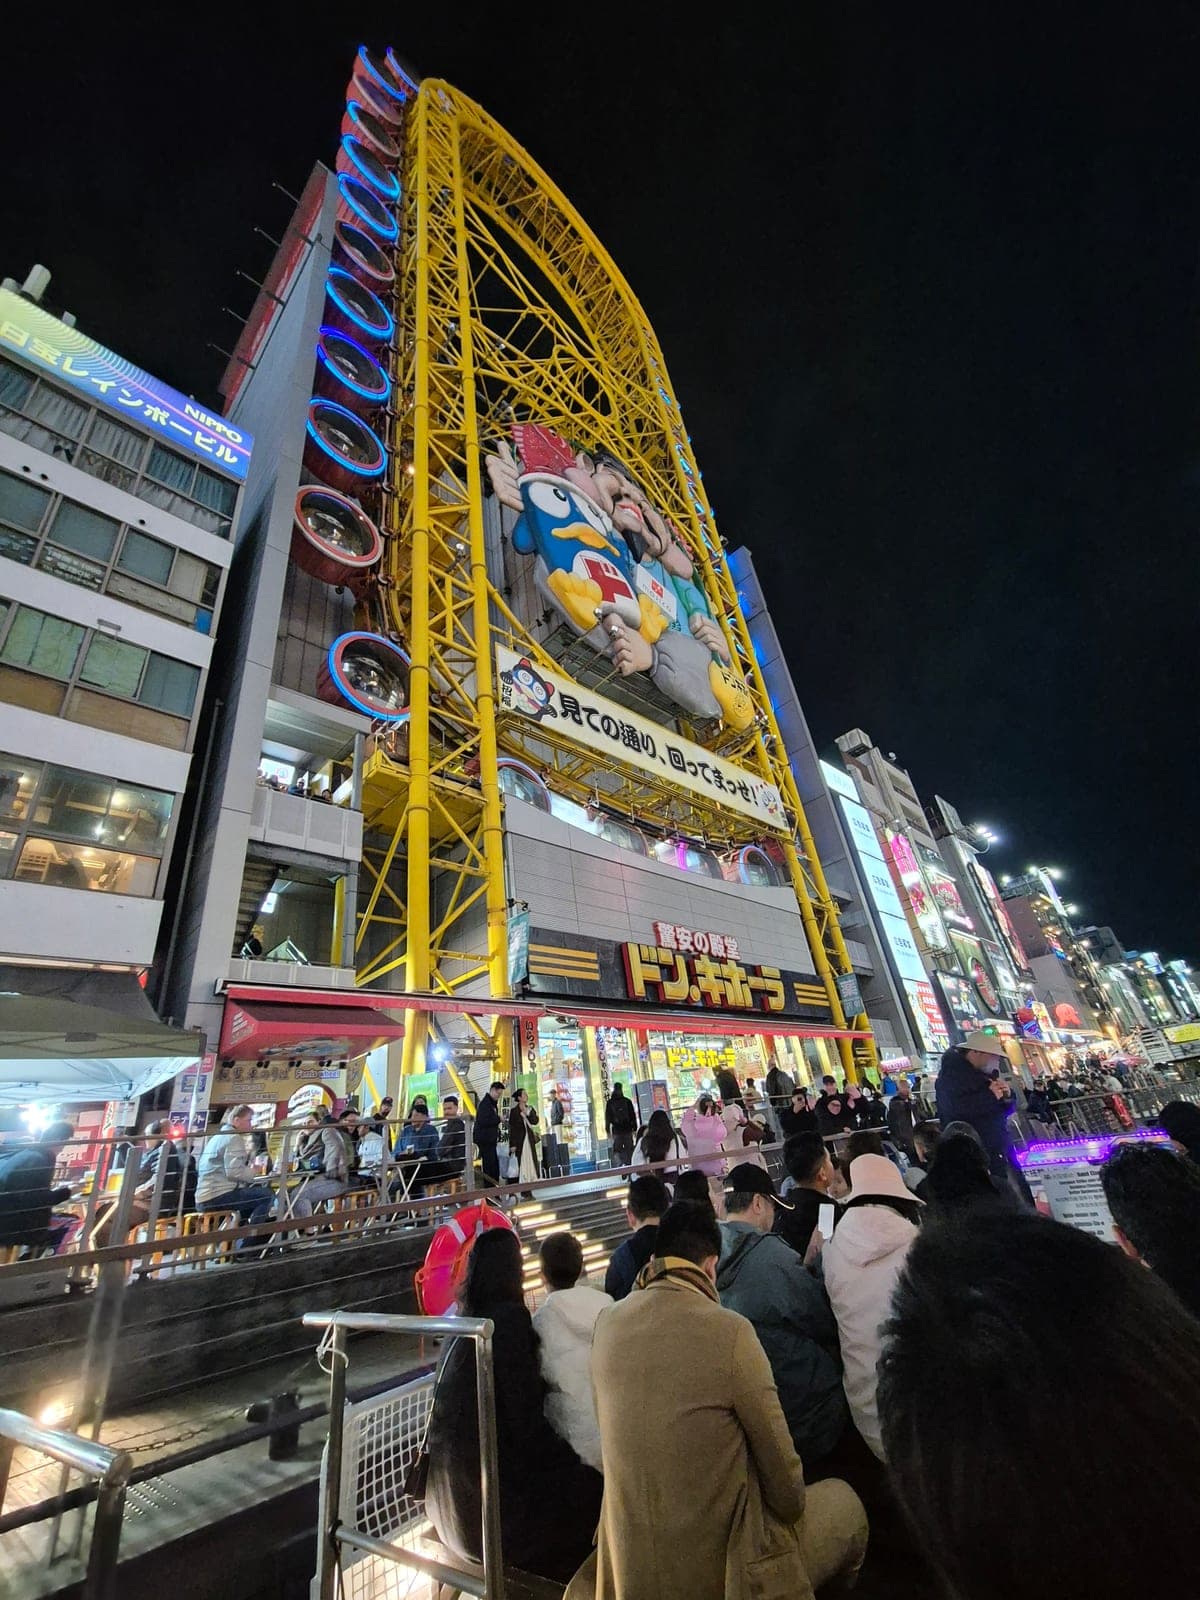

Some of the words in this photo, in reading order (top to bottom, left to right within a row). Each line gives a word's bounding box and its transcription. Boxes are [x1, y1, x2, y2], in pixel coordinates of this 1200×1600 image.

[184, 403, 243, 444] NIPPO
[653, 921, 741, 961] 驚安の殿堂
